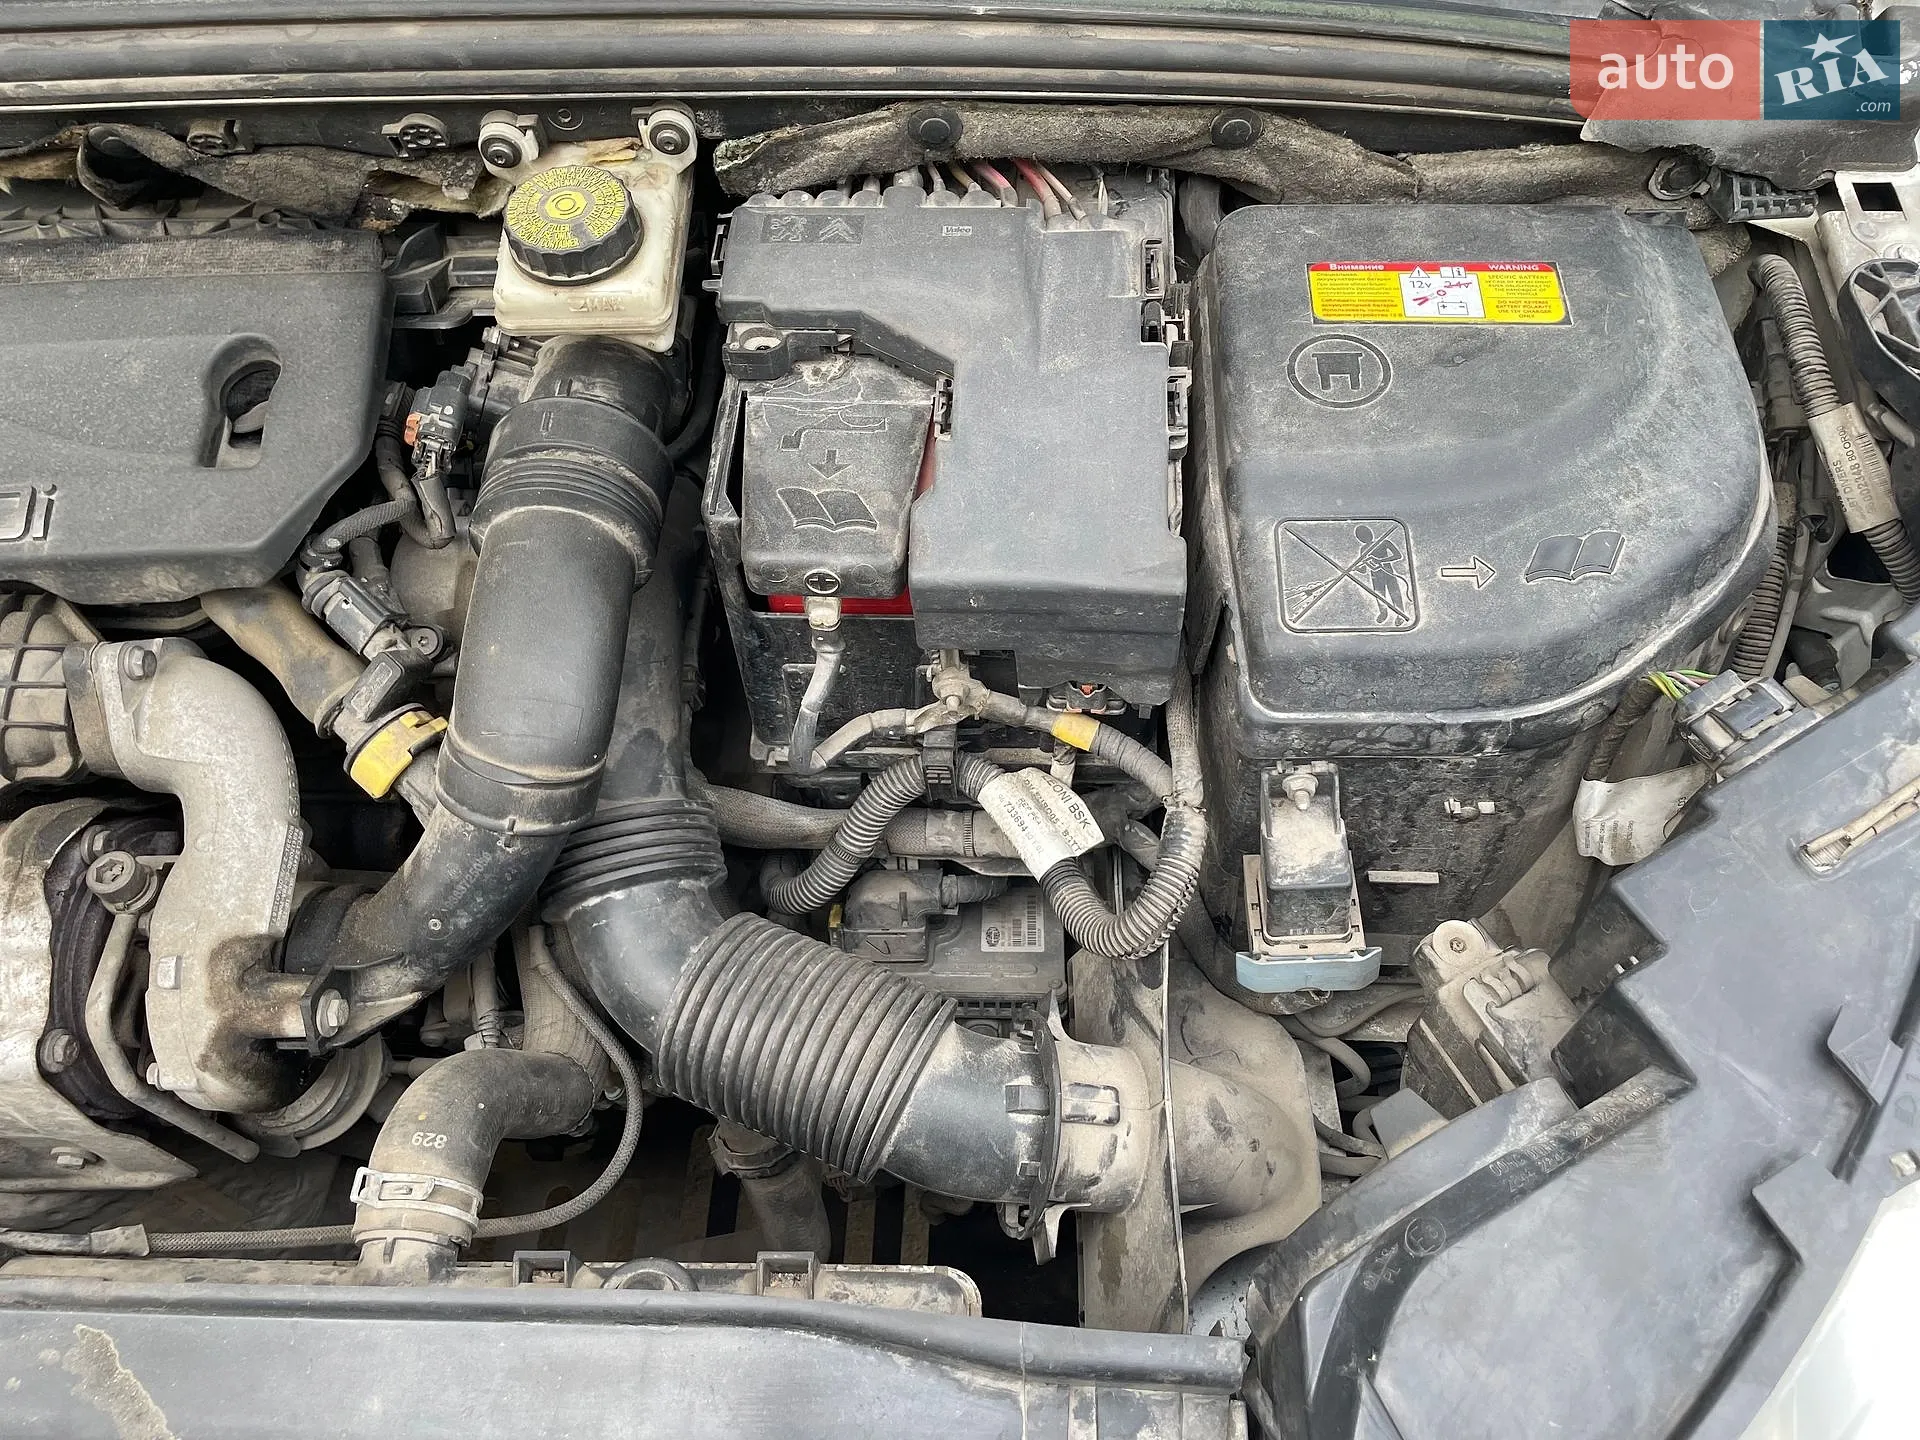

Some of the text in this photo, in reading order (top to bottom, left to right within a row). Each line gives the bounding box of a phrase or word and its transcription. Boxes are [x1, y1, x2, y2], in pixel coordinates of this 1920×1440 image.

[1833, 460, 1853, 495] DIVERS
[1042, 776, 1092, 830] LEONI BSK
[411, 1132, 447, 1148] 829
